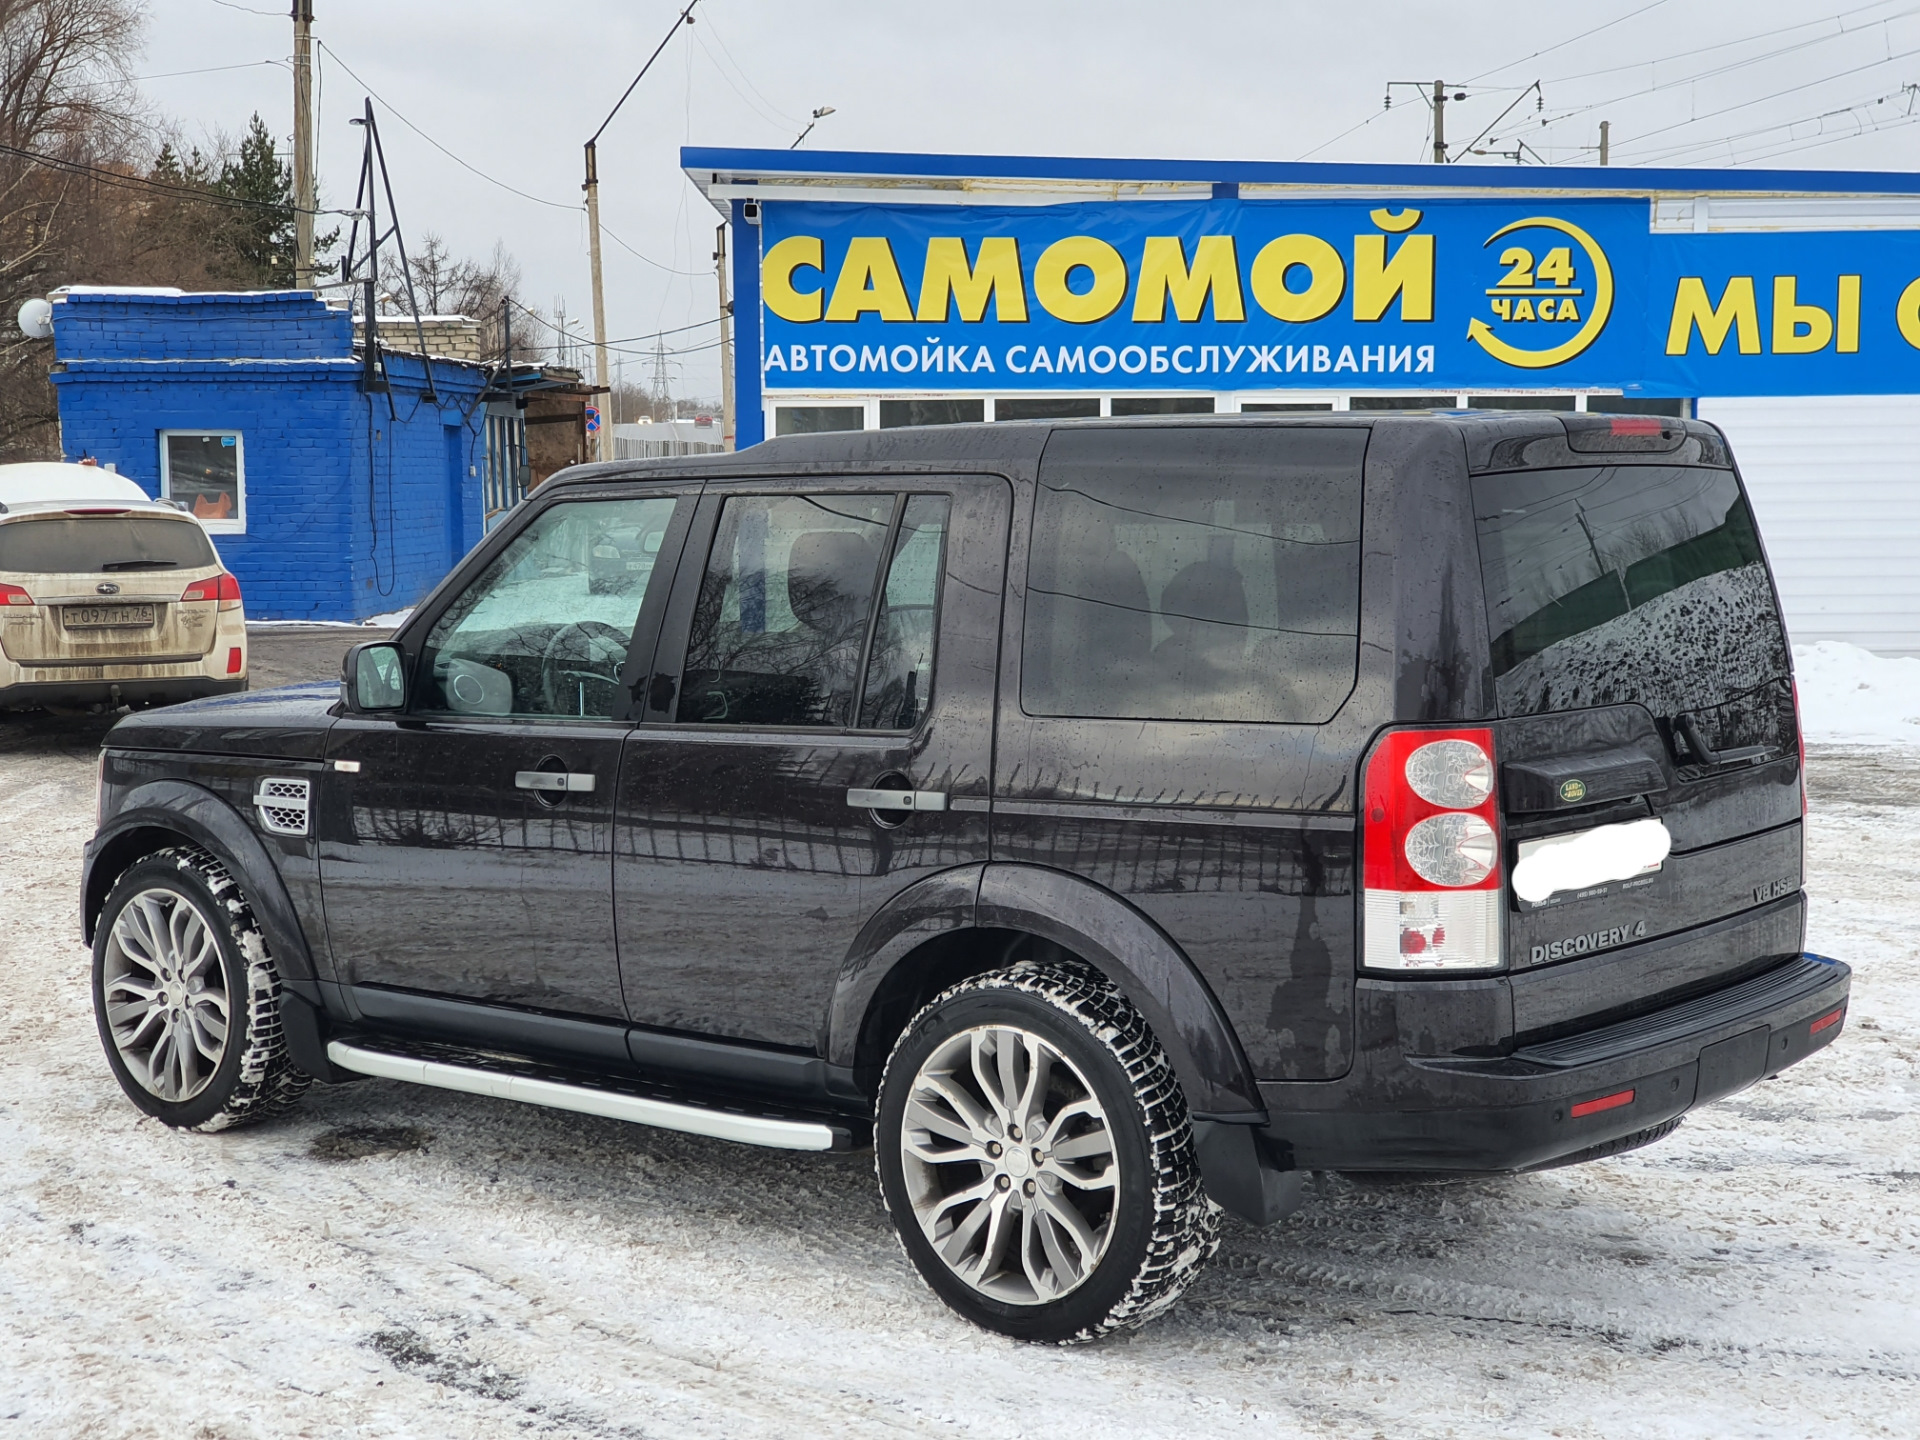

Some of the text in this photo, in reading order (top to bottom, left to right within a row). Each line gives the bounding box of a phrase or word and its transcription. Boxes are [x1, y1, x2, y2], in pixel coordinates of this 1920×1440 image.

[762, 207, 1436, 324] САМОМОЙ
[1499, 247, 1575, 288] 24
[1490, 298, 1581, 322] ЧАСА
[1665, 274, 1862, 356] МЫ
[764, 337, 1435, 374] АВТОМОЙКА САМООБСЛУЖИВАНИЯ
[1530, 920, 1647, 964] DISCOVERY 4
